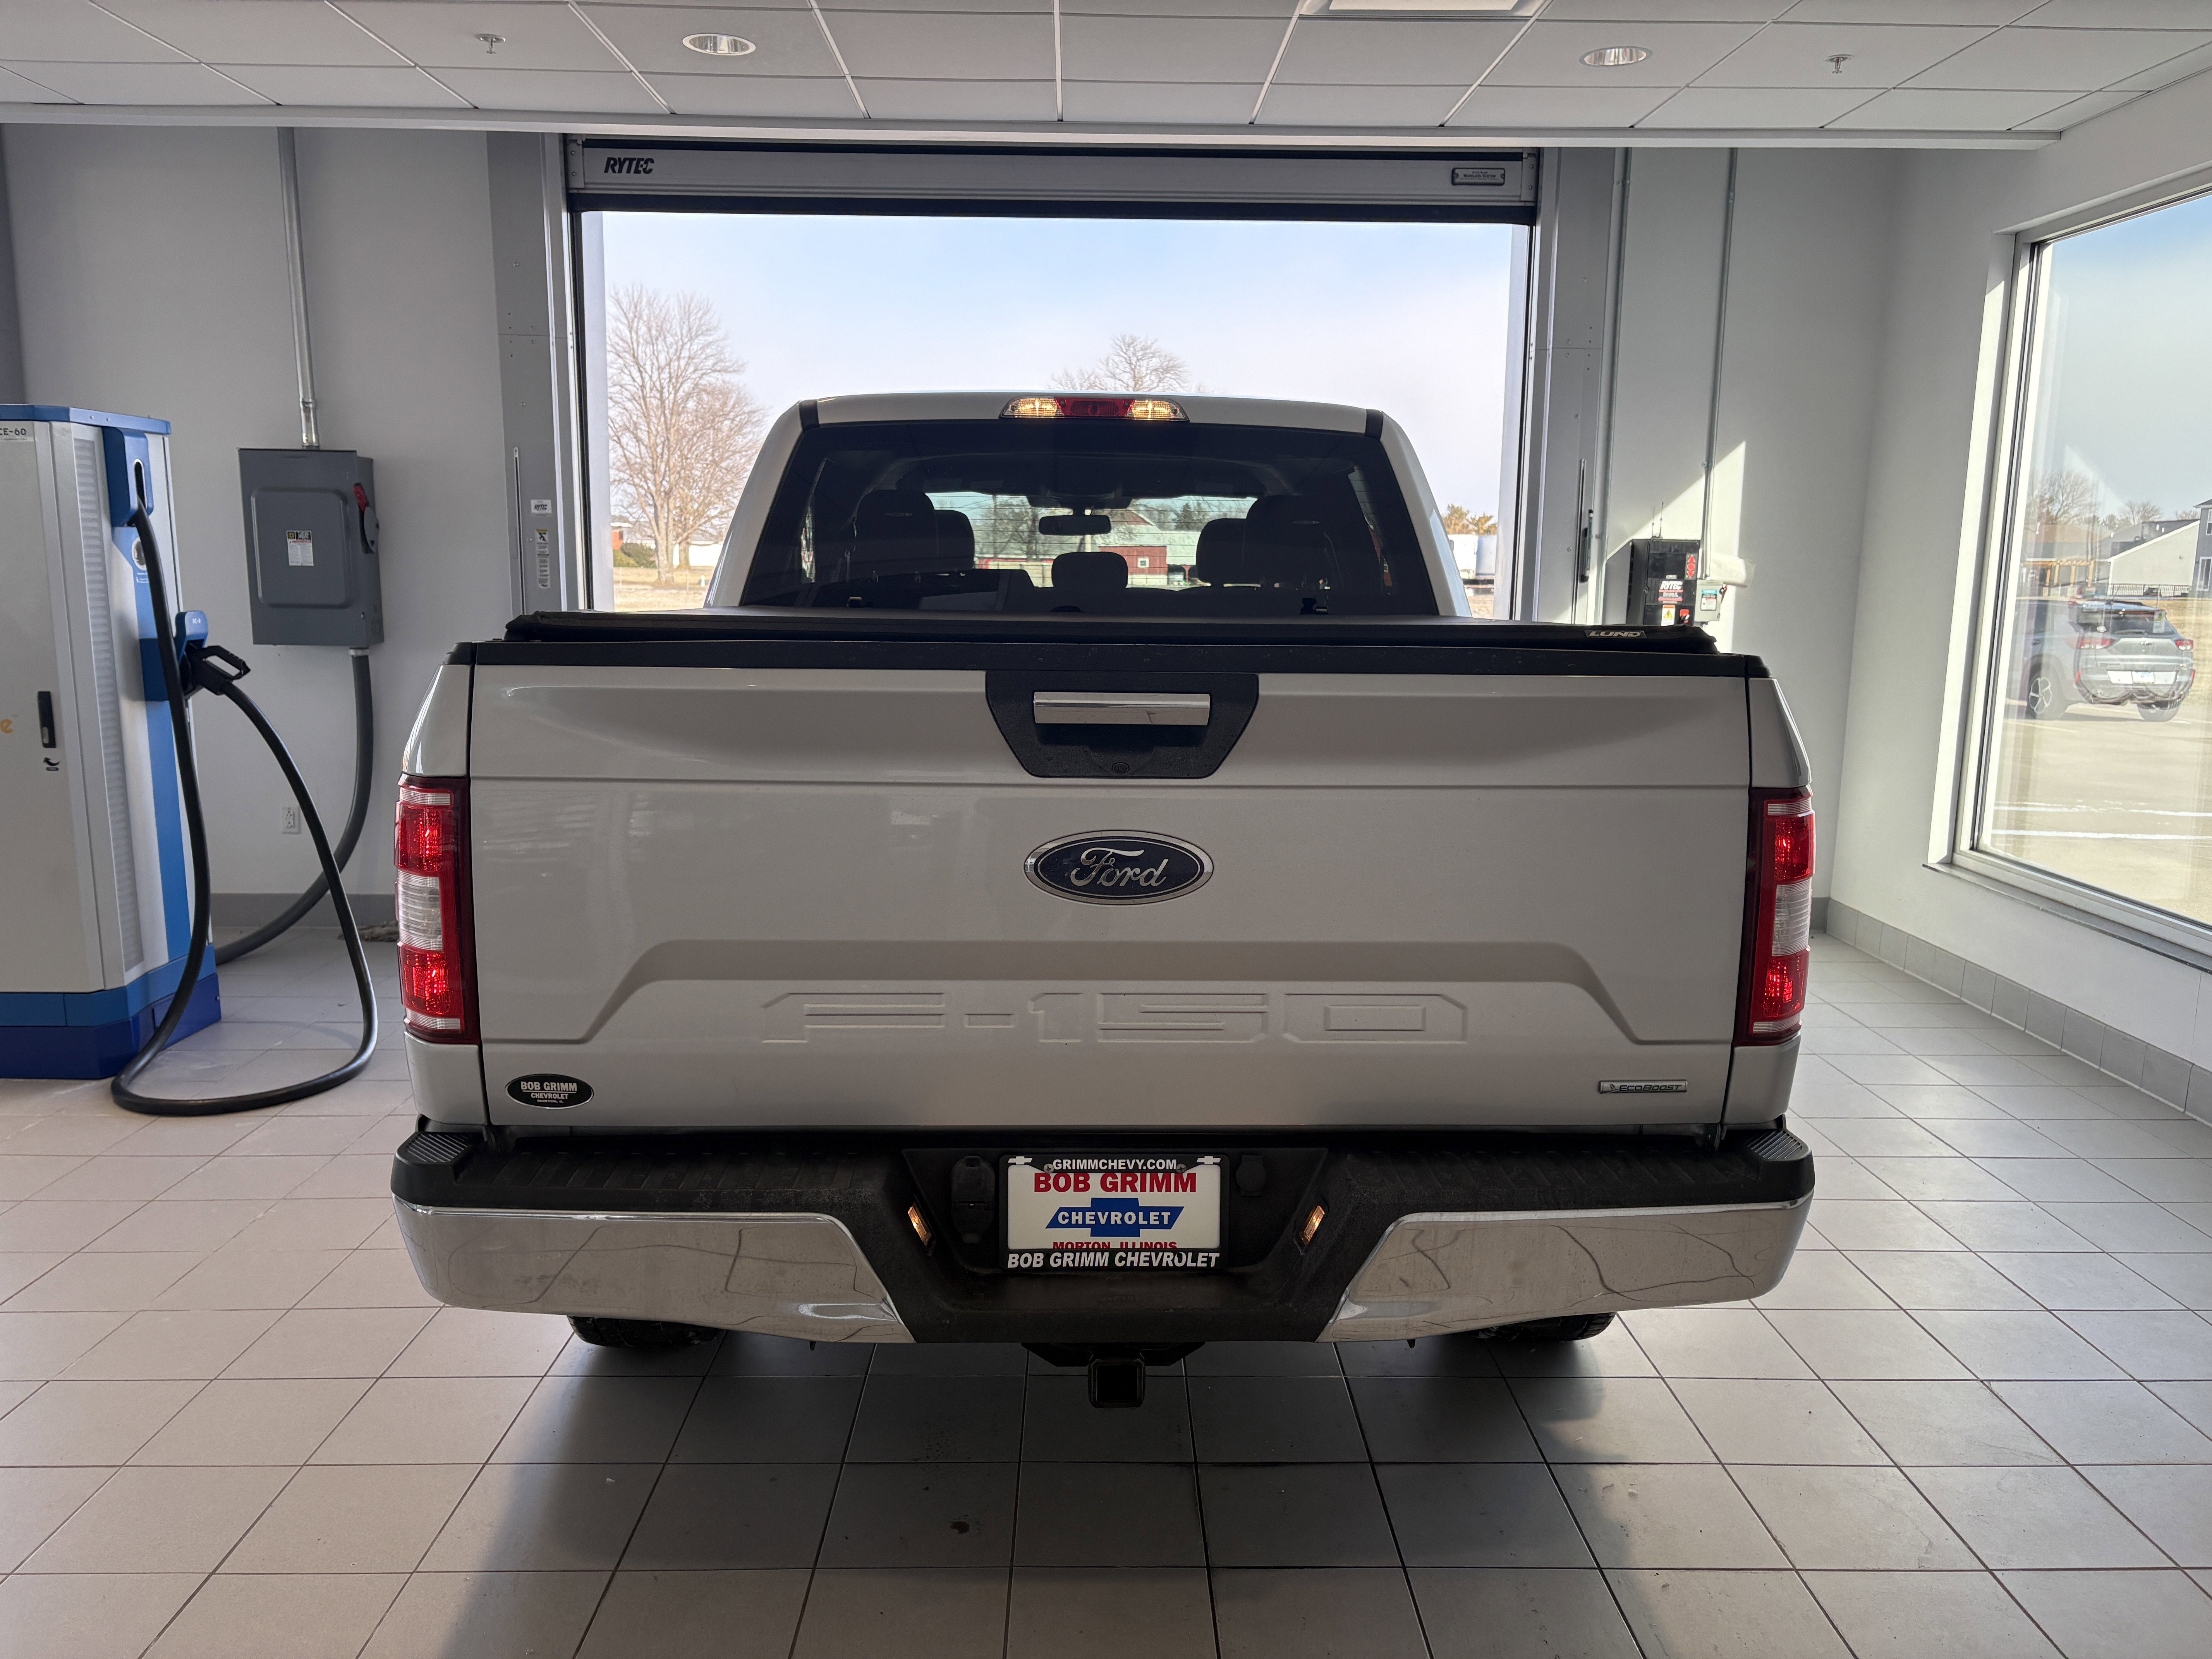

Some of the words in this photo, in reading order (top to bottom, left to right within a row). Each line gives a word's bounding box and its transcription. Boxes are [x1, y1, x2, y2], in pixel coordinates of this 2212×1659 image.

[604, 157, 654, 174] RYTEC
[1070, 847, 1169, 887] Ford
[761, 992, 1468, 1044] F-150
[520, 1081, 541, 1090] BOB
[543, 1082, 577, 1092] GRIMM
[1053, 1159, 1176, 1170] GRIMMCHEVY.COM
[1034, 1173, 1091, 1192] BOB
[1100, 1173, 1196, 1192] GRIMM
[1058, 1211, 1171, 1224] CHEVROLET
[1008, 1253, 1044, 1268] BOB
[1050, 1252, 1109, 1267] GRIMM
[1115, 1252, 1220, 1267] CHEVROLET
